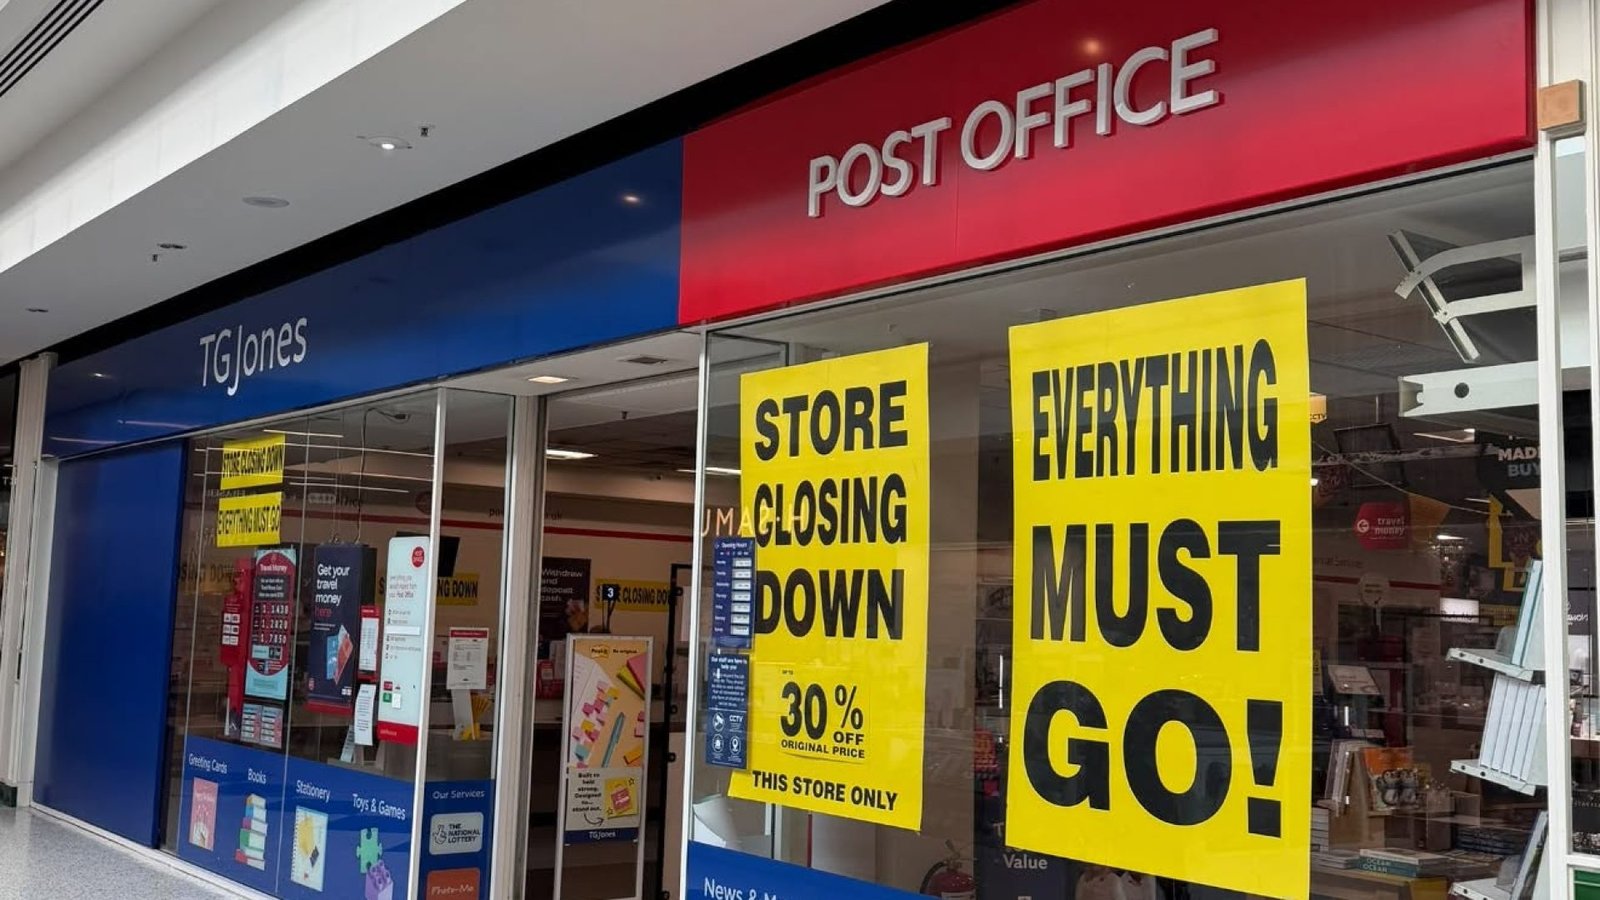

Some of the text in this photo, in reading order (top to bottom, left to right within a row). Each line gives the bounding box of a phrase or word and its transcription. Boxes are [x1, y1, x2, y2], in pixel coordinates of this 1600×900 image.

[808, 28, 1220, 218] POST OFFICE
[1032, 338, 1279, 481] EVERYTHING
[755, 380, 908, 461] STORE
[222, 443, 282, 477] STORE CLOSING DOWN
[218, 505, 280, 534] EVERYTHING MUST GO
[754, 473, 907, 547] CLOSING
[1377, 515, 1405, 525] travel
[1374, 527, 1405, 536] money
[317, 563, 350, 578] Get your
[316, 578, 338, 590] travel
[452, 580, 479, 598] DOWN
[607, 586, 614, 598] 3
[1030, 518, 1281, 652] MUST
[315, 593, 342, 607] money
[623, 587, 655, 605] CLOSING
[755, 568, 905, 641] DOWN
[729, 714, 744, 722] CCTV
[833, 731, 864, 746] OFF
[781, 739, 865, 759] ORIGINAL PRICE
[188, 753, 228, 774] Greeting Cards
[1022, 679, 1283, 839] GO!
[247, 768, 267, 785] Books
[296, 779, 331, 803] Stationery
[432, 789, 485, 799] Our Services
[752, 770, 898, 811] THIS STORE ONLY
[352, 793, 406, 821] Toys & Games
[448, 829, 480, 837] NATIONAL
[448, 836, 477, 844] LOTTERY
[1003, 854, 1048, 869] Value
[704, 876, 743, 900] News
